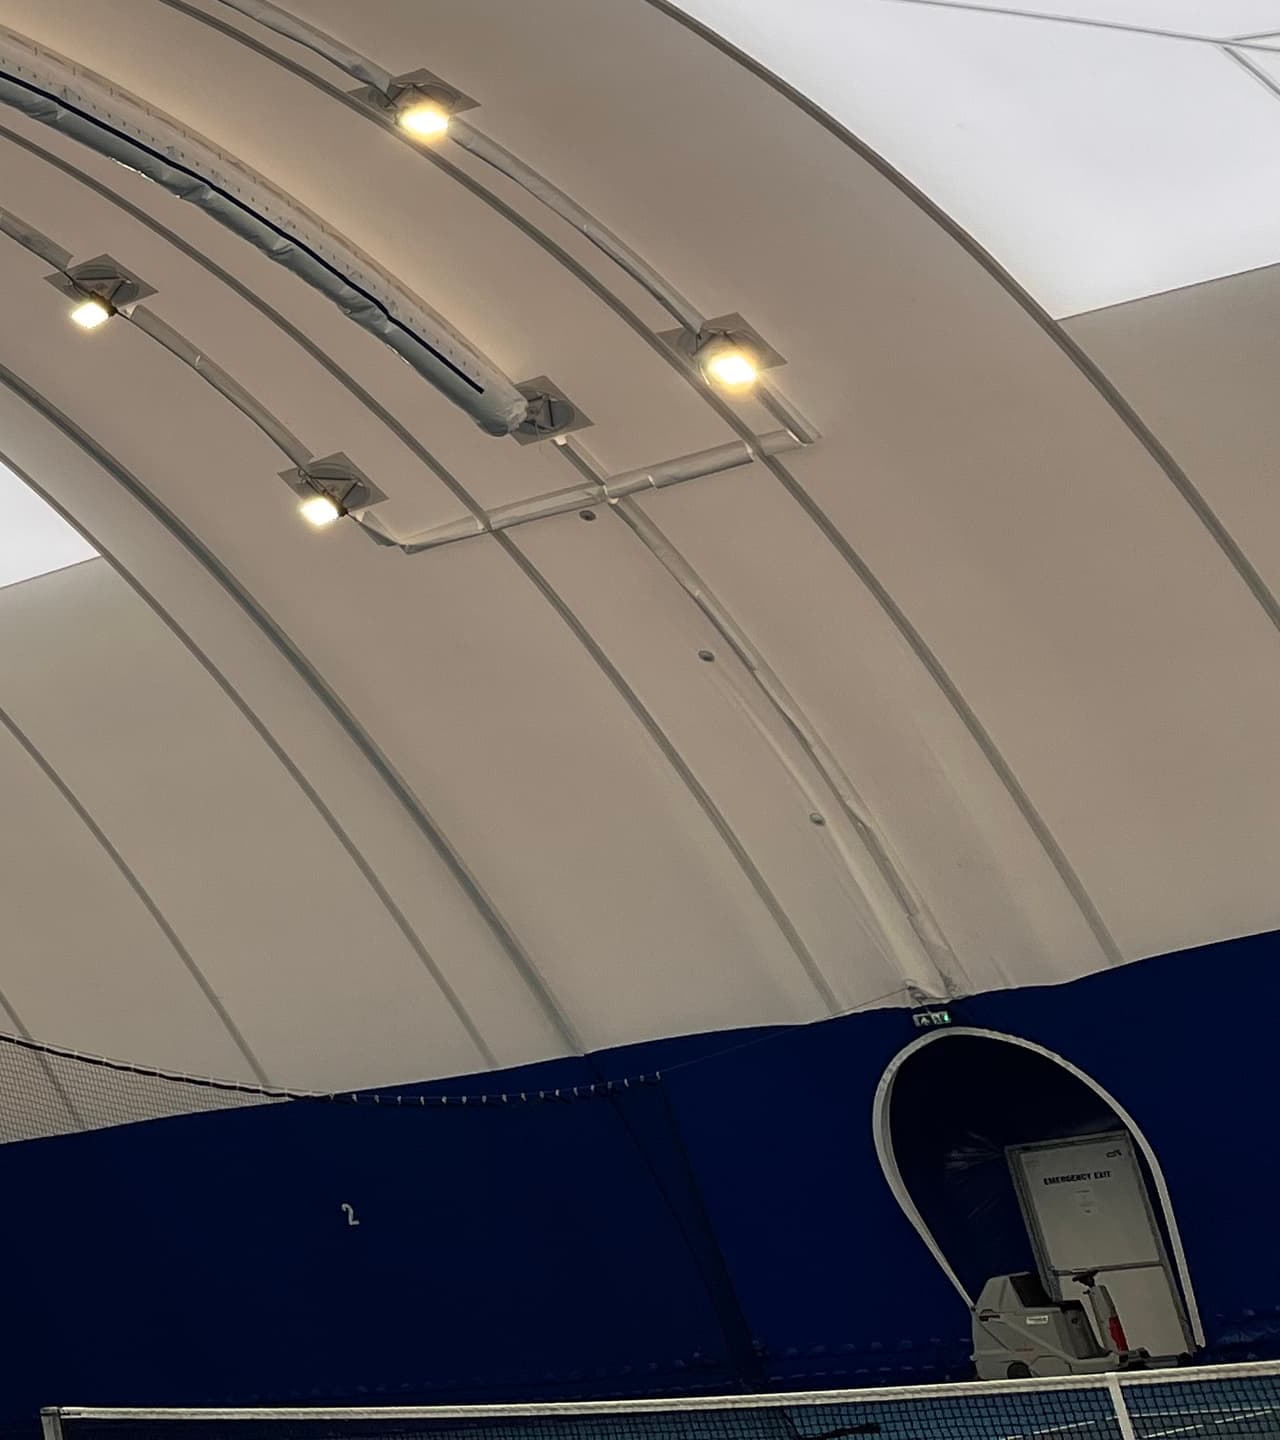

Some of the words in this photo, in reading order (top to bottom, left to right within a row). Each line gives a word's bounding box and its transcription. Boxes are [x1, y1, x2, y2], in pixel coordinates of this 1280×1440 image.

[1043, 1173, 1091, 1185] EMERGENCY
[1094, 1170, 1111, 1179] EXIT
[341, 1203, 360, 1226] 2
